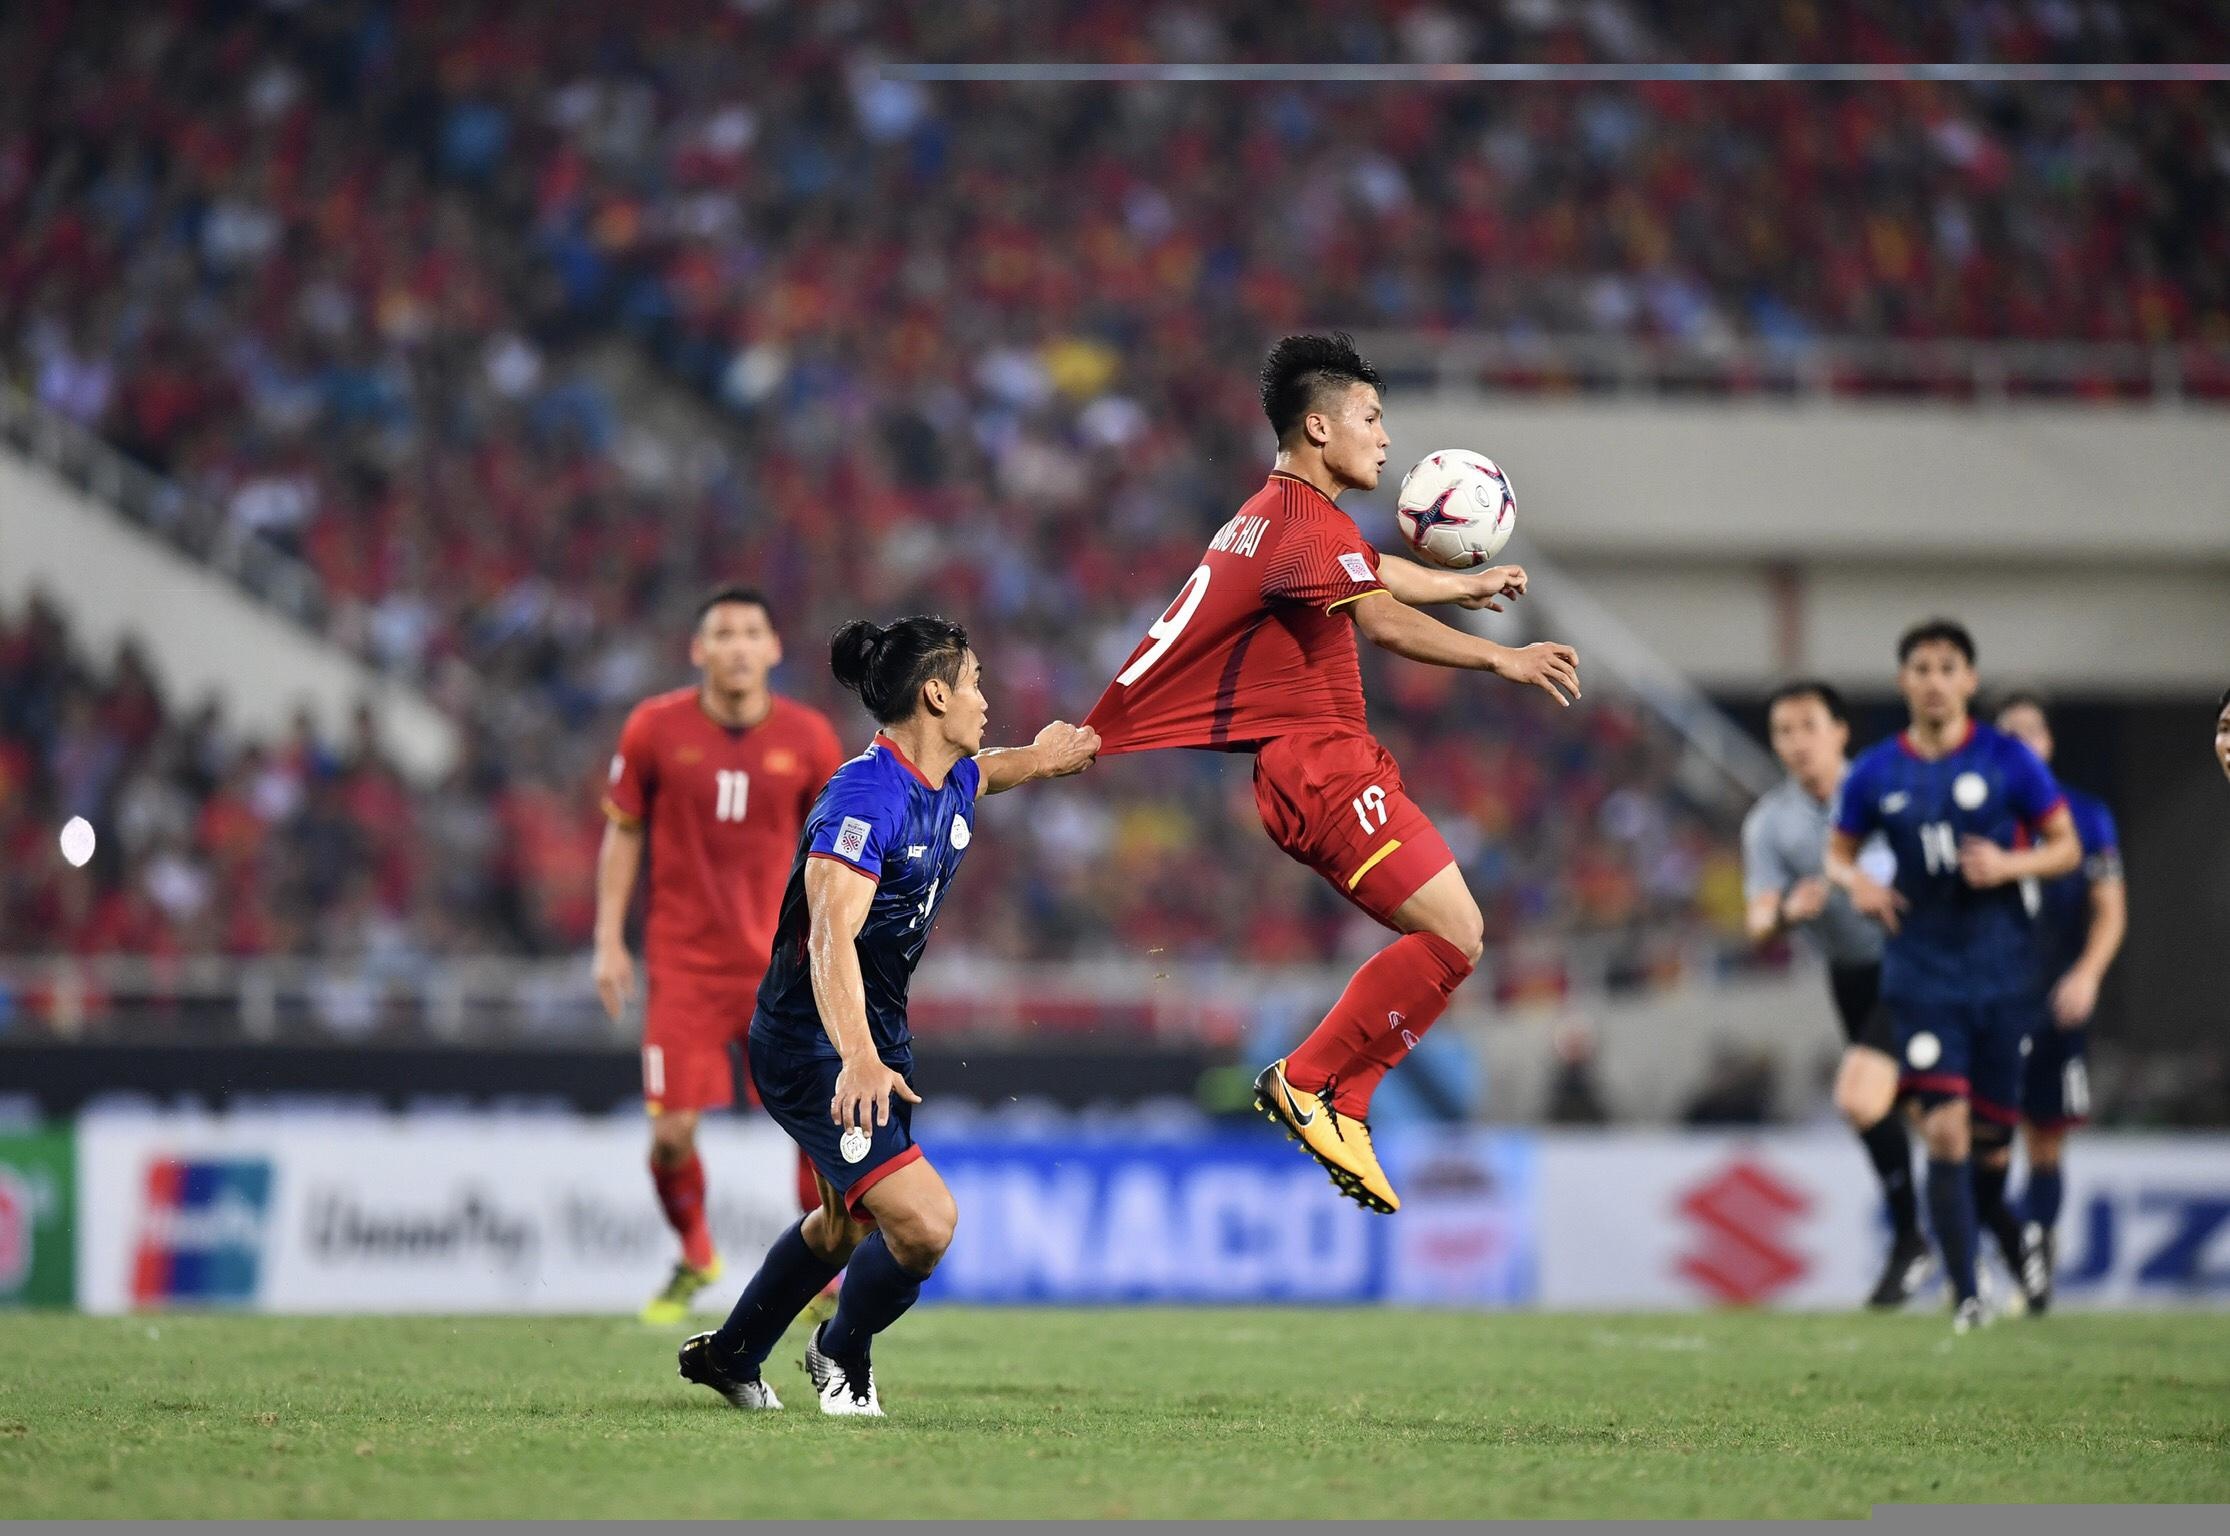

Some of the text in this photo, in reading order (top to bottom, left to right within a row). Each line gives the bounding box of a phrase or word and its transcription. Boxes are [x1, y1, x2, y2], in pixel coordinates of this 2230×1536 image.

[1208, 515, 1271, 558] ANG HAI
[715, 769, 749, 823] 11
[1352, 784, 1388, 836] 19
[944, 1158, 1374, 1291] INACO
